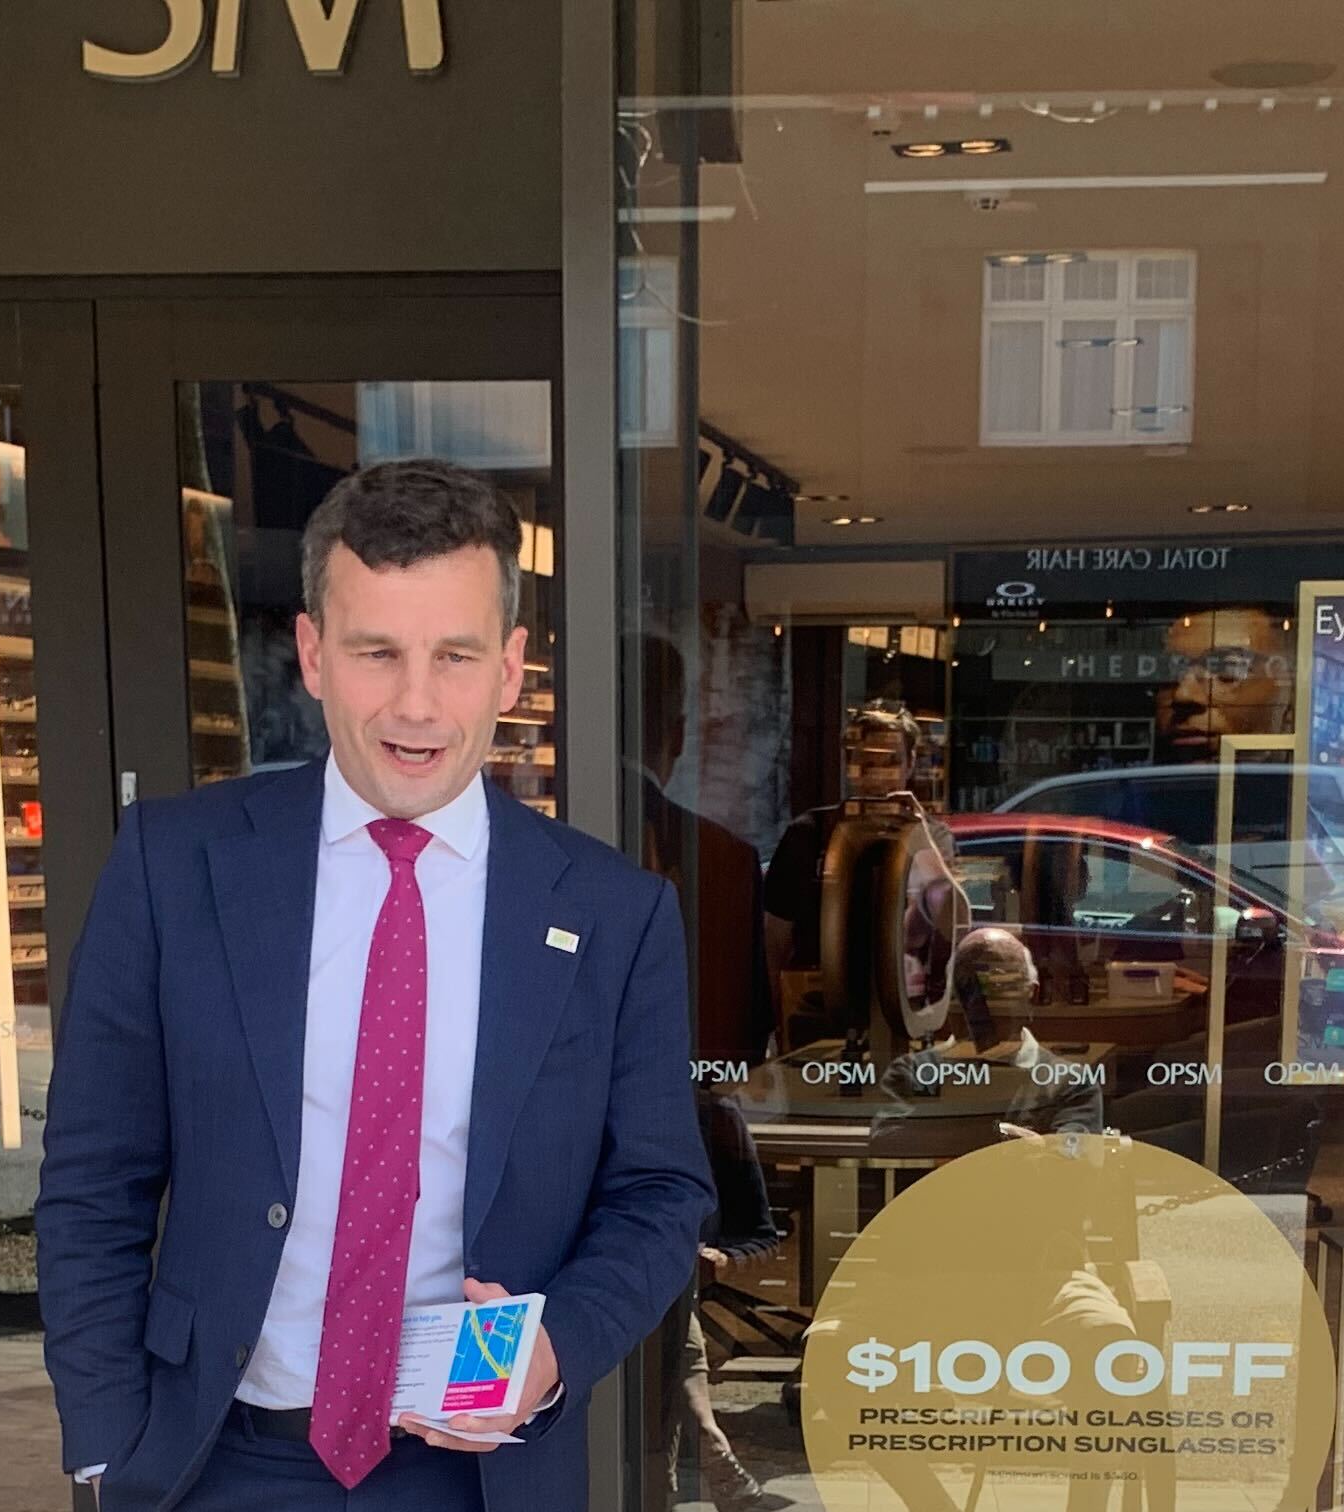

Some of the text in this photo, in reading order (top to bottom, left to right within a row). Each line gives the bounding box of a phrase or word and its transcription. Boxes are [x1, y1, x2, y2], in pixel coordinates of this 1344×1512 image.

[691, 1060, 749, 1083] PSM
[801, 1061, 877, 1085] OPSM
[915, 1061, 991, 1086] OPSM
[1030, 1062, 1106, 1086] OPSM
[1146, 1062, 1223, 1086] OPSM
[1263, 1061, 1344, 1085] OPSM
[845, 1336, 1294, 1397] $100 OFF
[859, 1406, 1275, 1429] PRESCRIPTION GLASSES OR
[847, 1434, 1068, 1453] PRESCRIPTION
